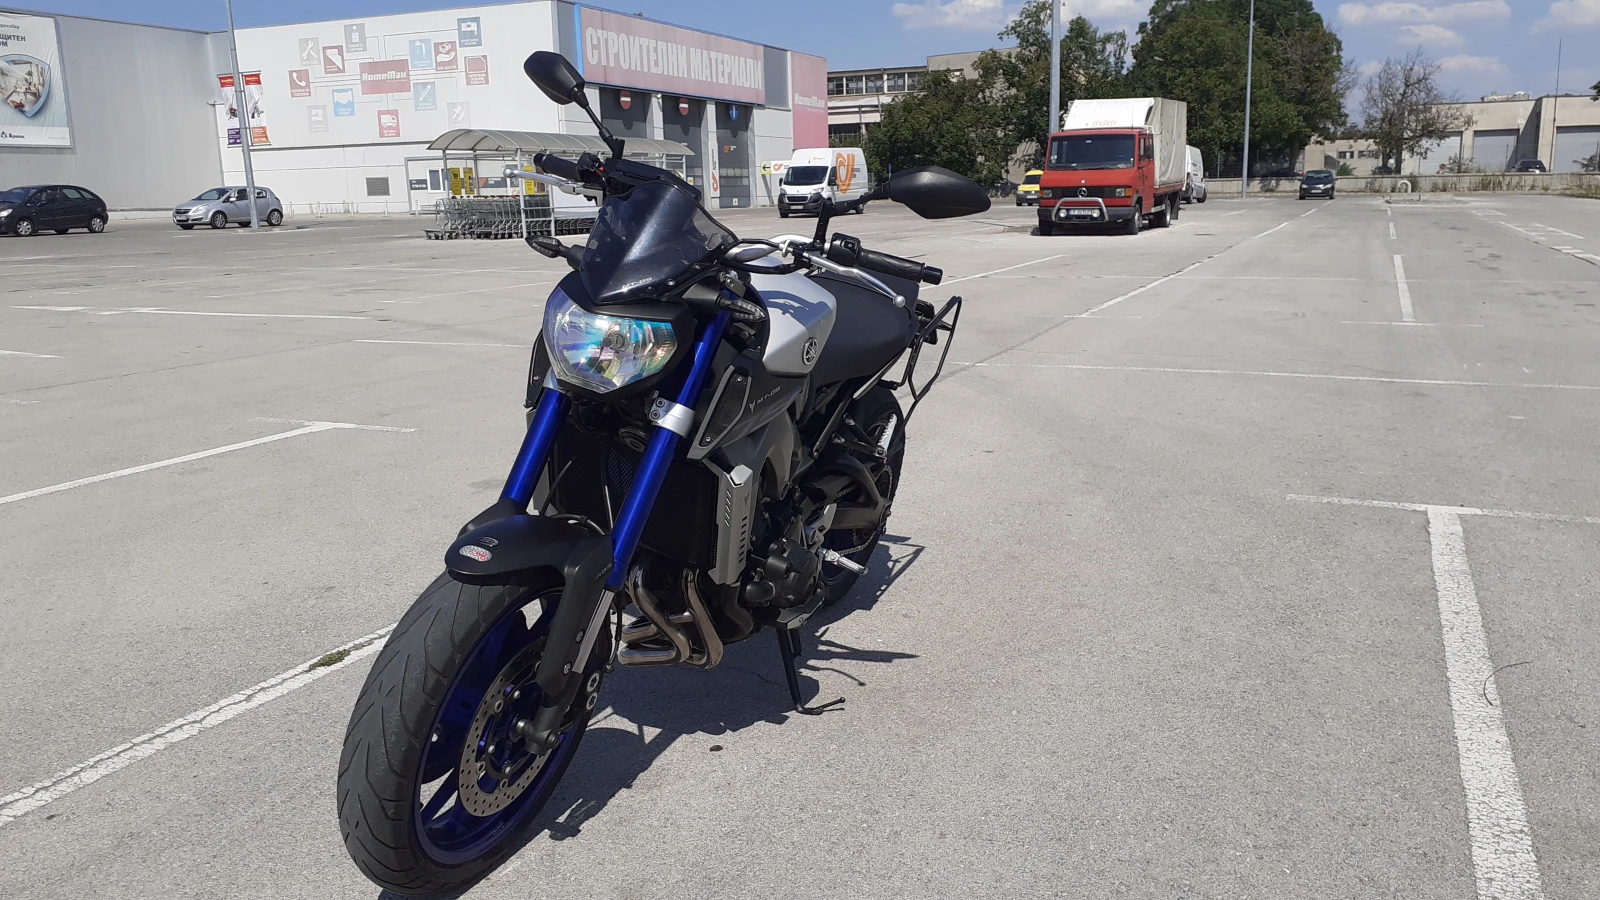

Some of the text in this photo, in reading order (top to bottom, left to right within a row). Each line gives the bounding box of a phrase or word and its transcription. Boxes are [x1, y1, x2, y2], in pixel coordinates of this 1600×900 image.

[585, 26, 763, 90] СТРОИТЕЛНИ МАТЕРИАЛИ
[756, 385, 781, 405] MT-09
